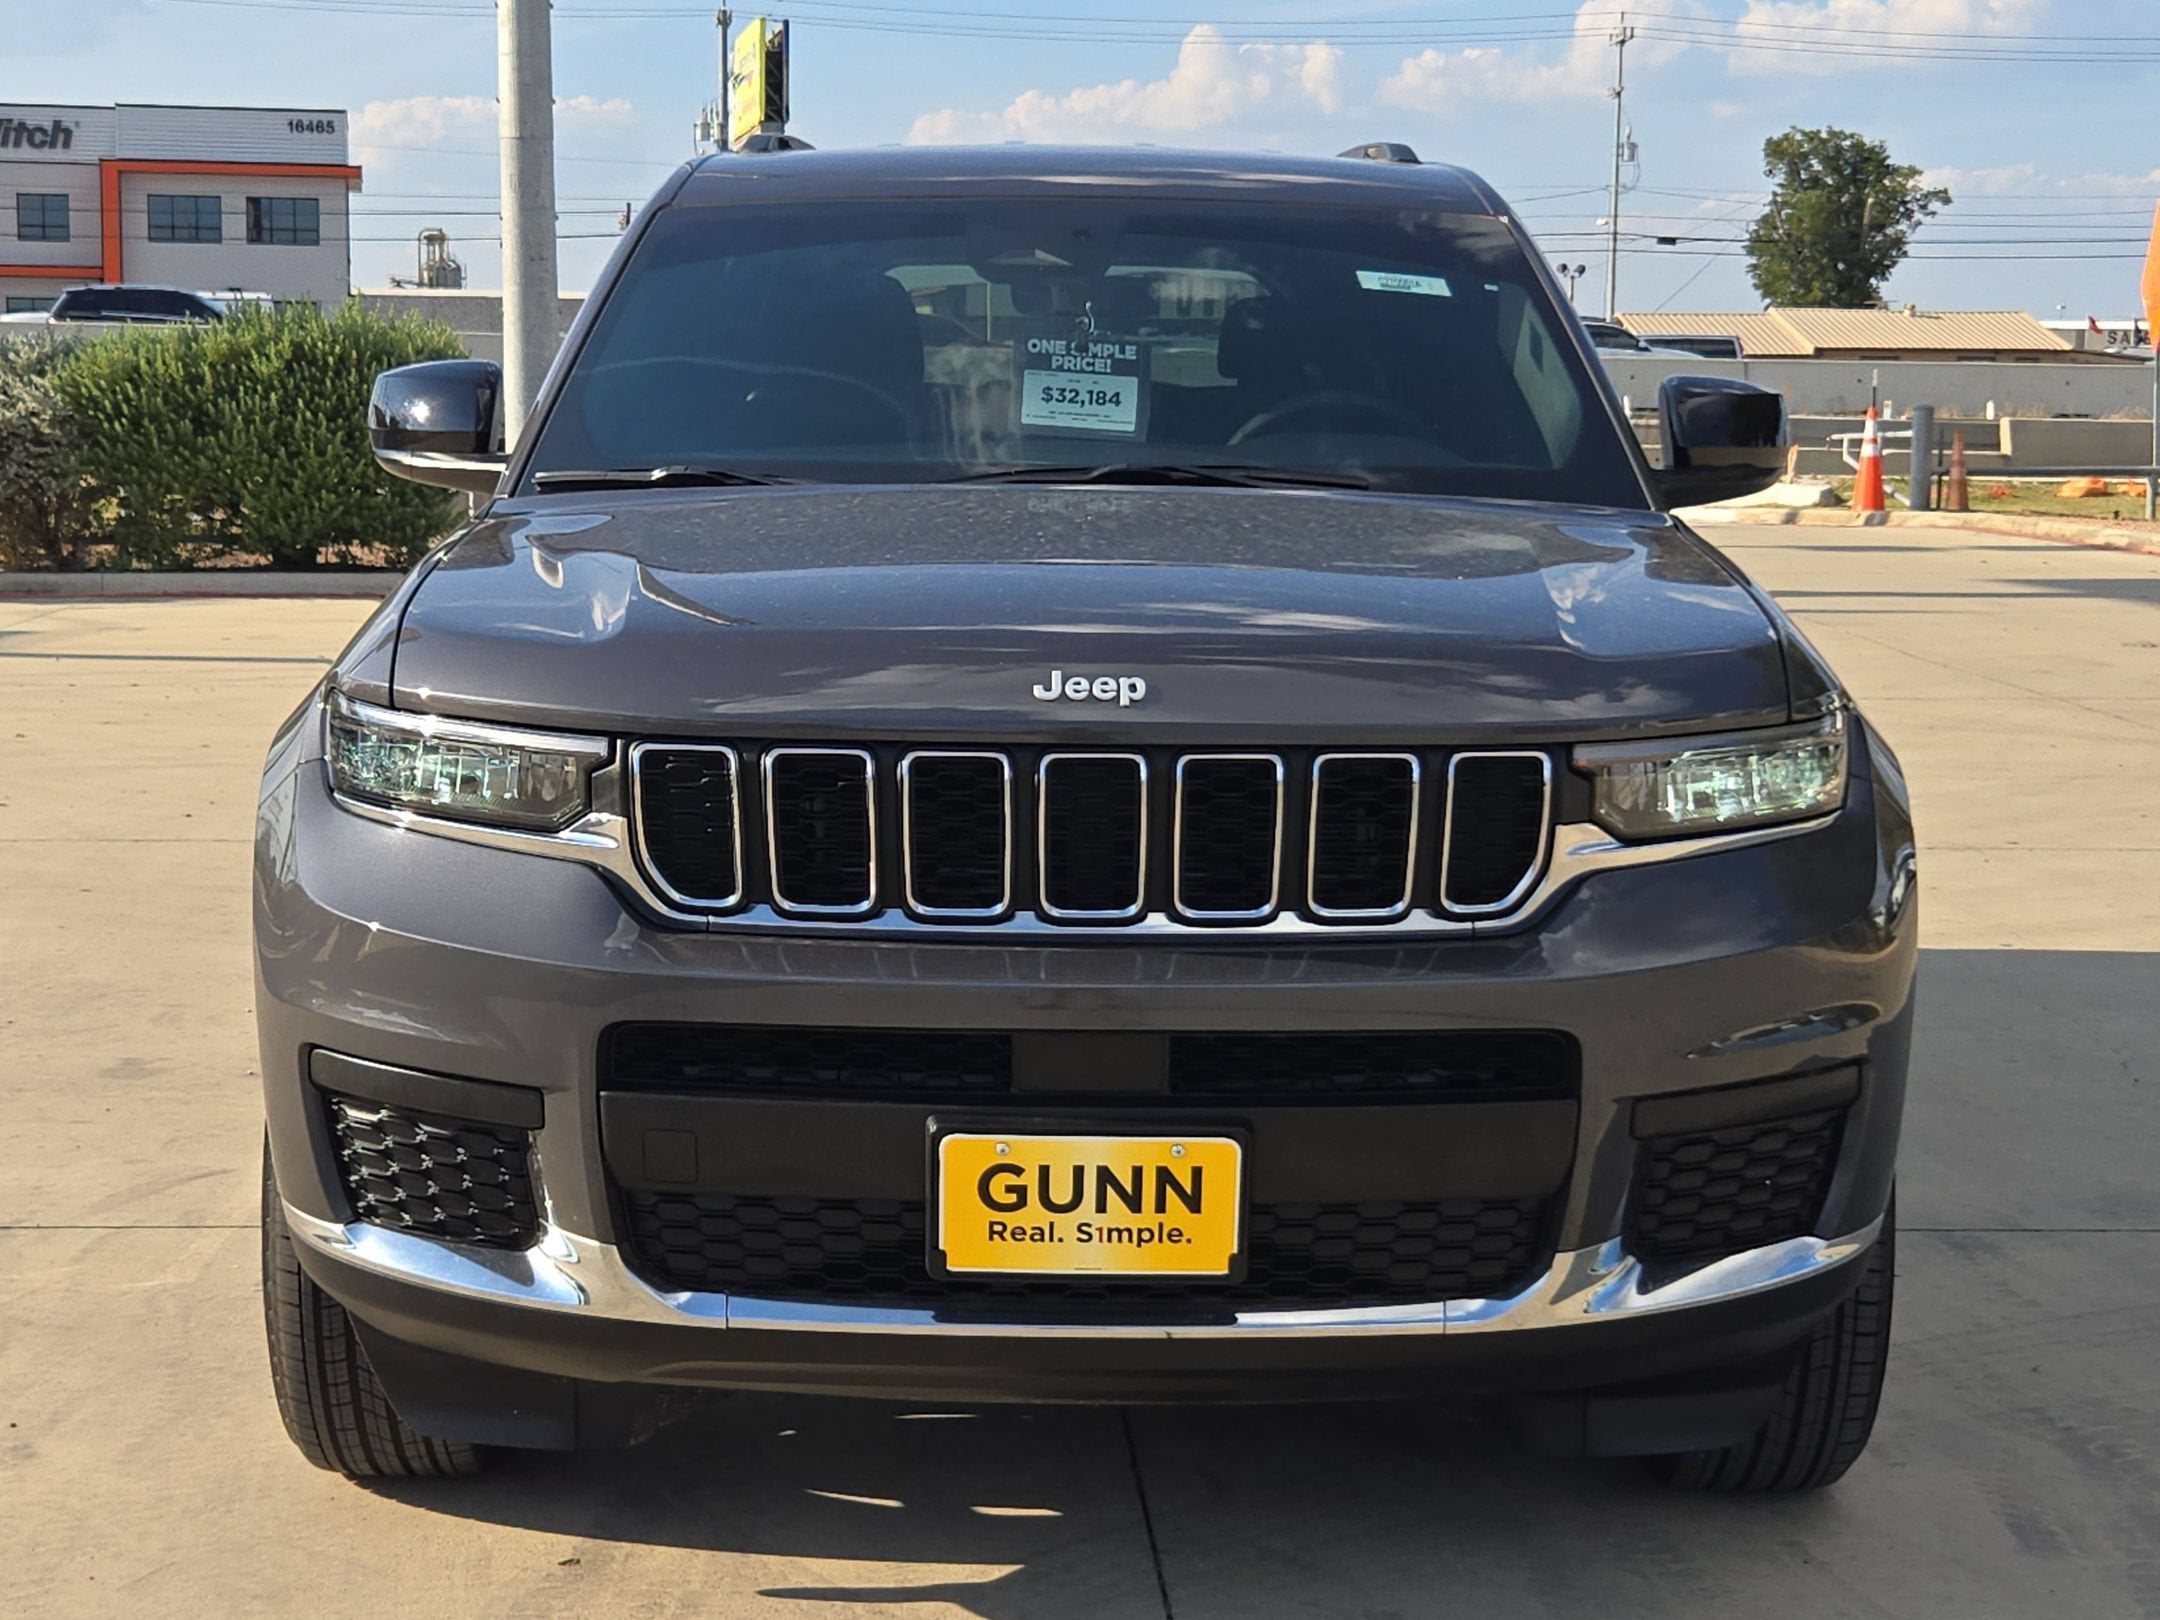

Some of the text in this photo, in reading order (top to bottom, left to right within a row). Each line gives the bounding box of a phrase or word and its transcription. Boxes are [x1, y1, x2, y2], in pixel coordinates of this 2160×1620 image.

[0, 118, 74, 149] itch
[287, 119, 336, 135] 16465
[1027, 338, 1137, 360] ONE SMPLE
[1051, 355, 1112, 373] PRICE!
[1041, 386, 1122, 408] $32,184
[1032, 669, 1146, 708] Jeep
[976, 1163, 1204, 1214] GUNN
[988, 1220, 1064, 1243] Real.
